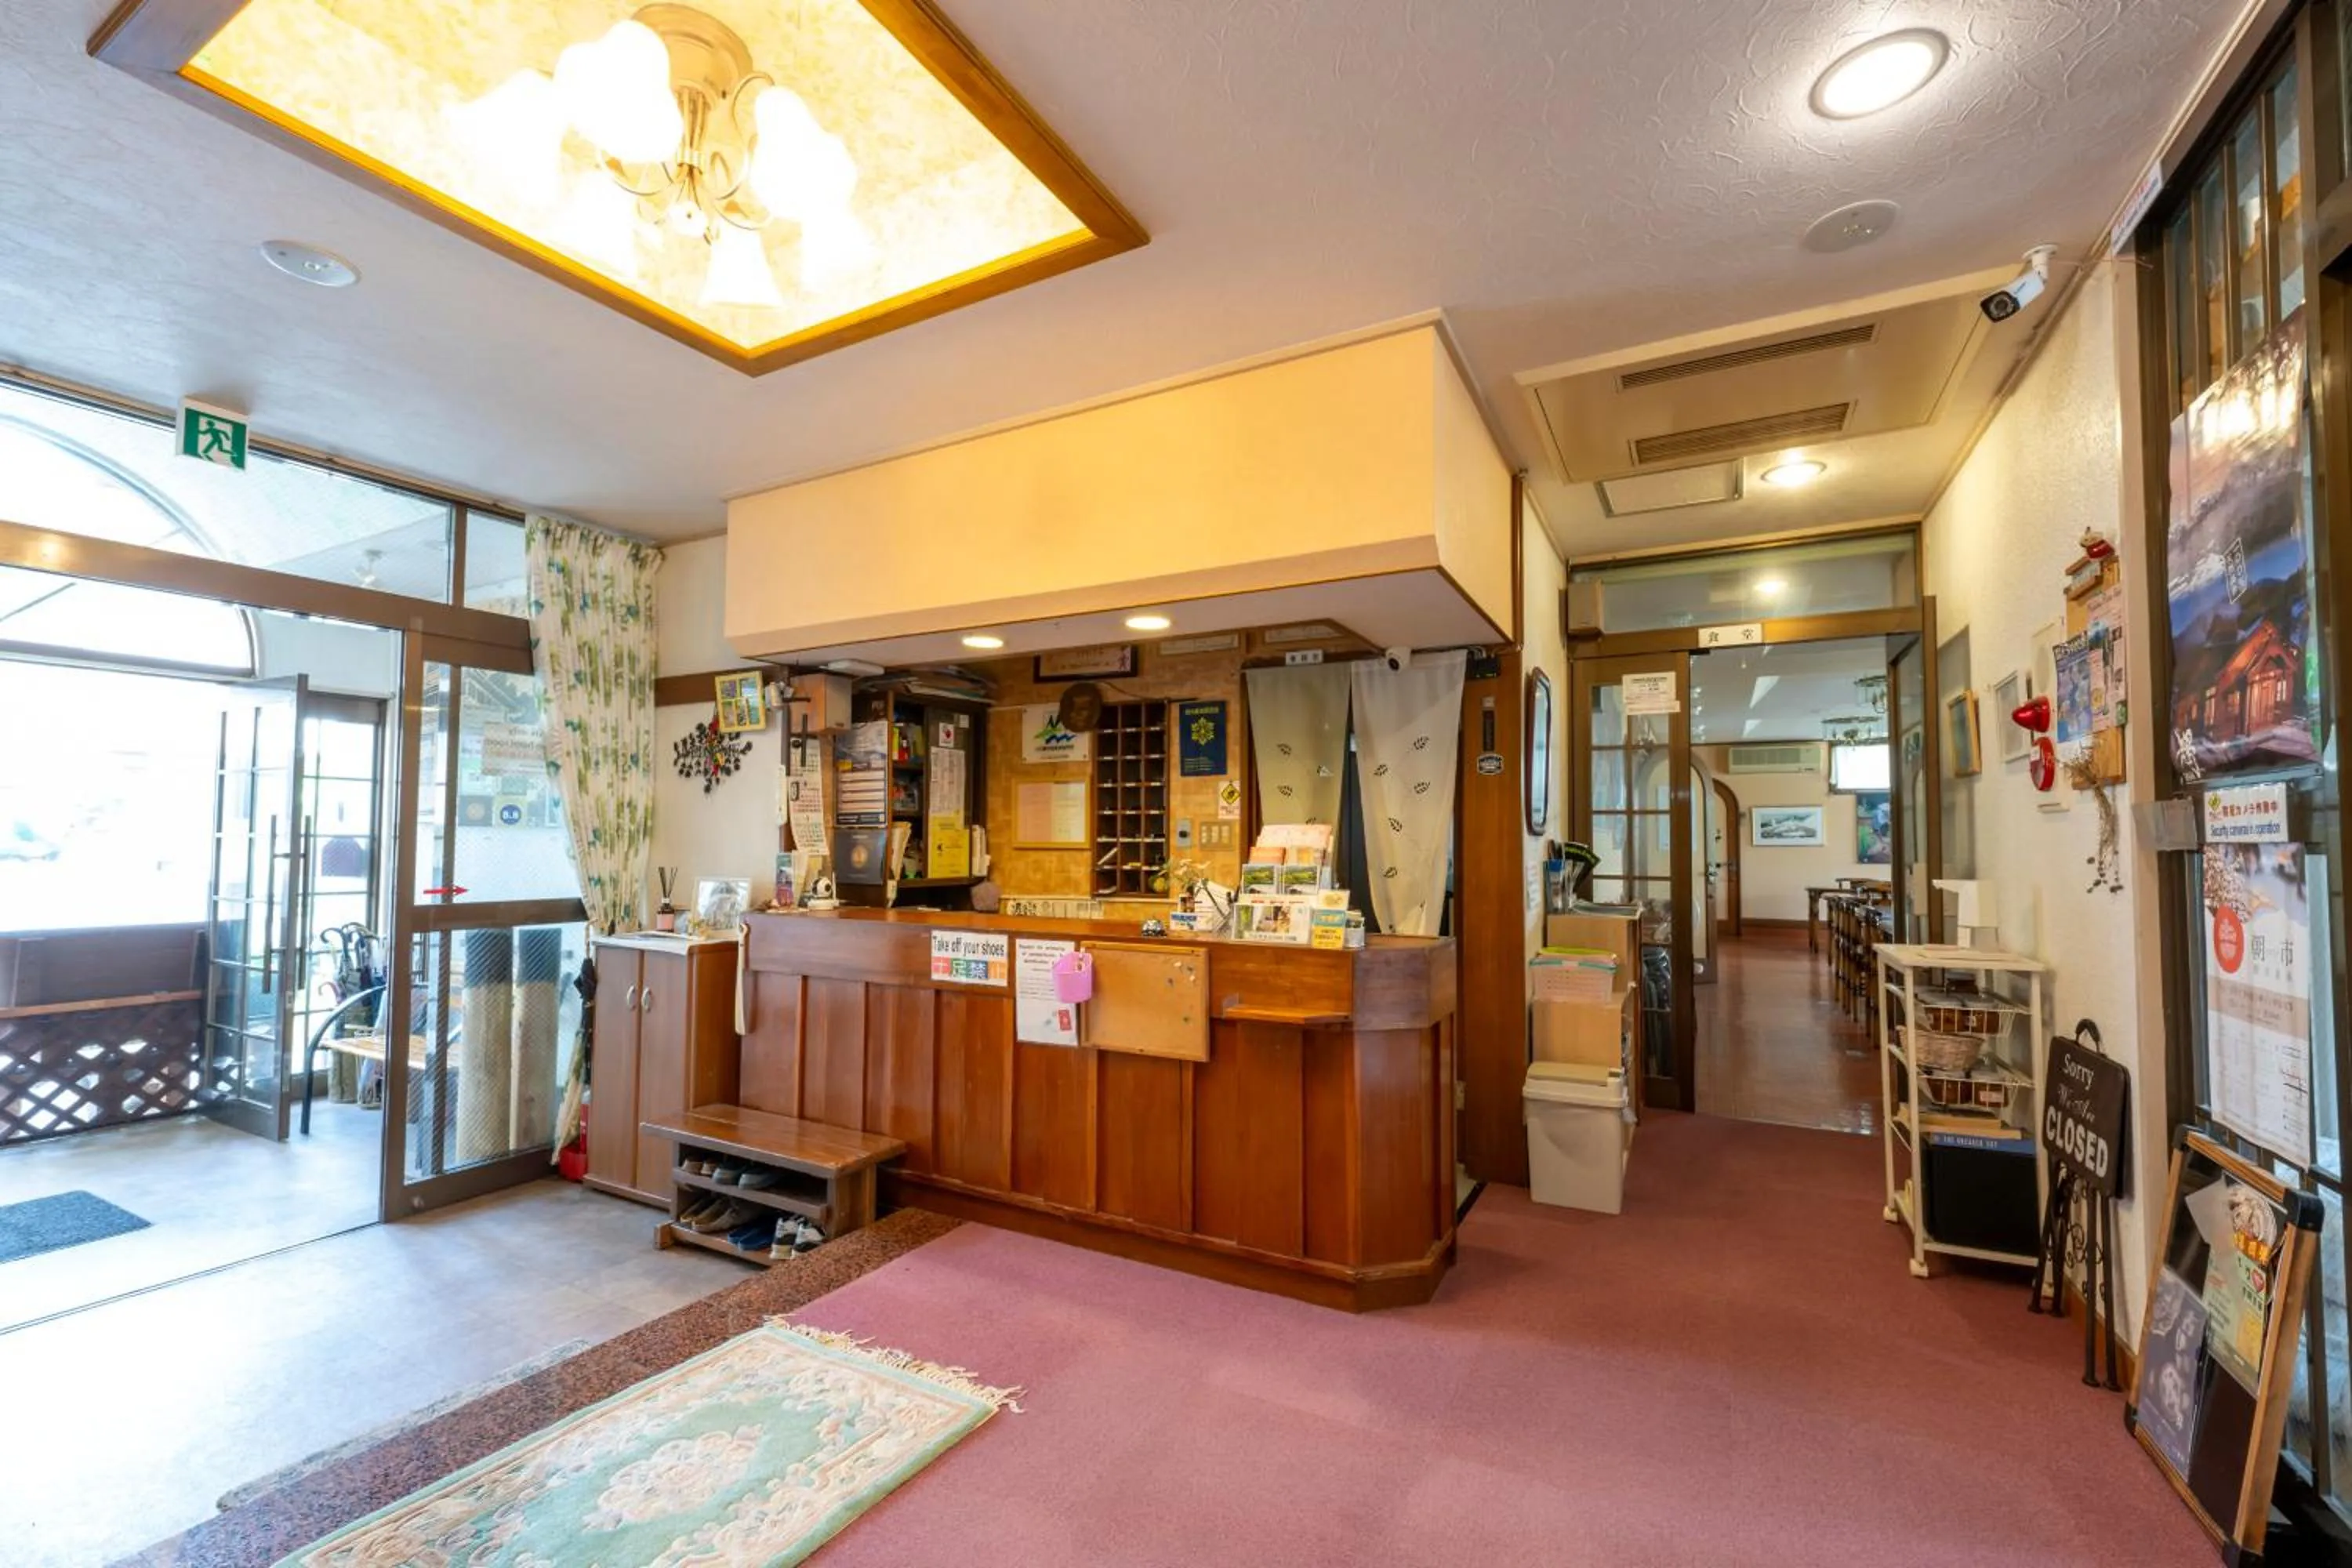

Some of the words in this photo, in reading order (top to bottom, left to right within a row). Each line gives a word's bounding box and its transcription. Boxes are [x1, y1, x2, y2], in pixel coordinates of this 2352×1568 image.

[932, 935, 949, 953] Take
[951, 936, 962, 953] off
[963, 941, 979, 957] your
[981, 940, 1005, 956] shoes
[2062, 1052, 2095, 1091] Sorry
[2045, 1105, 2109, 1178] CLOSED
